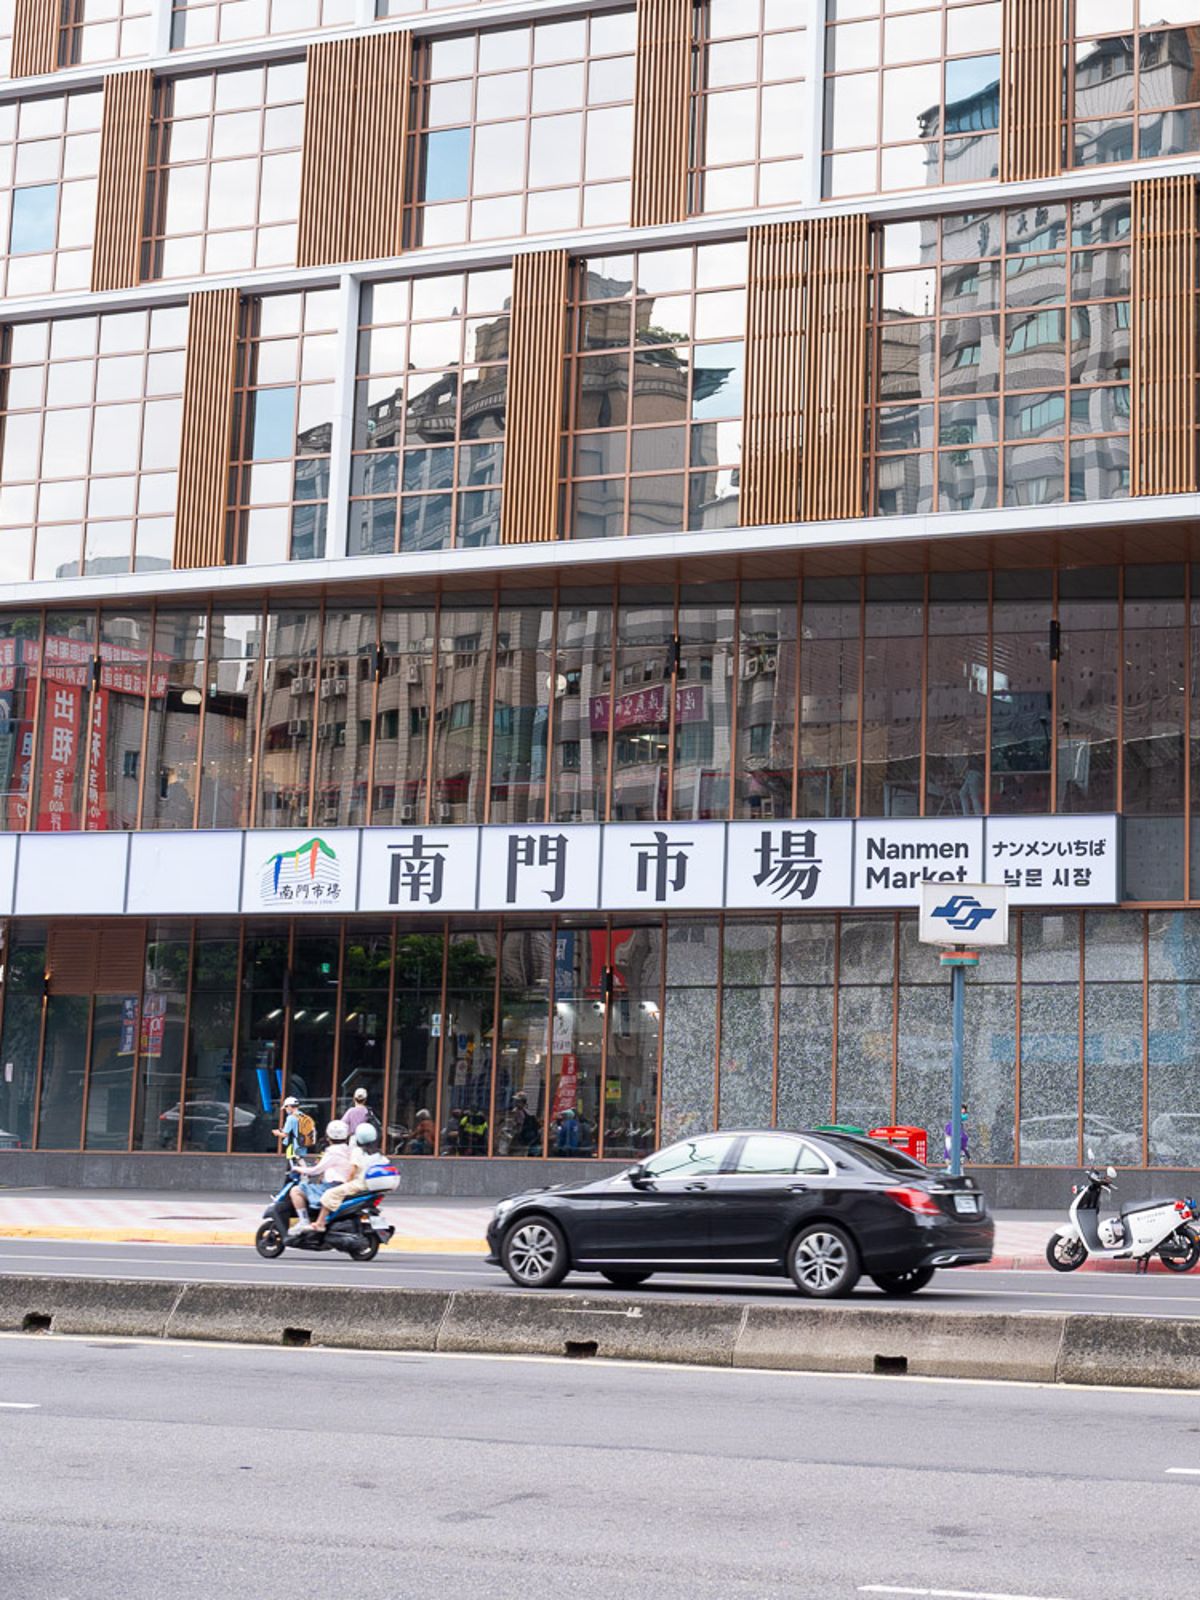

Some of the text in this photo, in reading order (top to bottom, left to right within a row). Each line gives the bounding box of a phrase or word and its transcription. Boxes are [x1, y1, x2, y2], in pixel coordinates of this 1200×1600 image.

[866, 837, 969, 860] Nanmen
[992, 838, 1106, 857] ナンメンいちば
[387, 828, 822, 904] 南門市場
[866, 865, 968, 889] Market
[1004, 868, 1092, 887] 남문 시장
[280, 883, 342, 900] 南門市場
